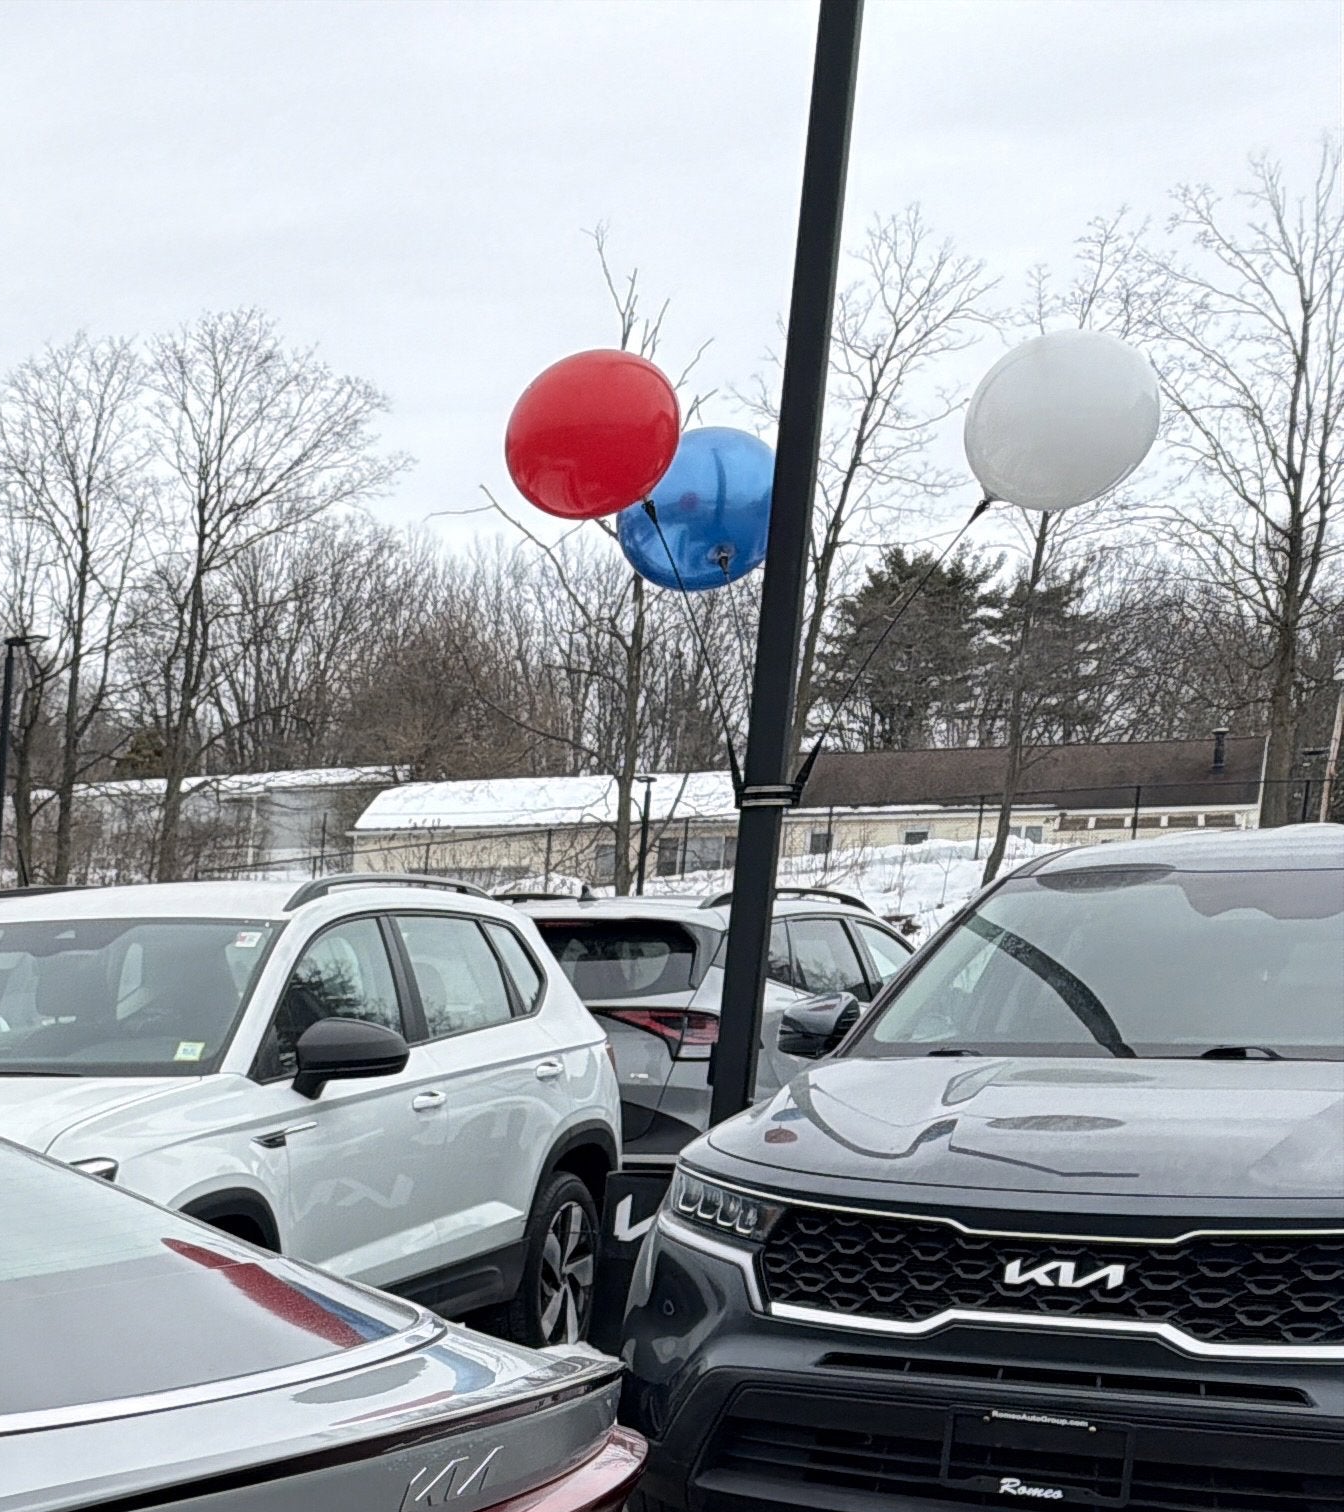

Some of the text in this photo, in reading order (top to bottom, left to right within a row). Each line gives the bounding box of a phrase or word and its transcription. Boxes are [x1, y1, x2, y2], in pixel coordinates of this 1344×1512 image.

[1004, 1258, 1125, 1289] KIA
[992, 1410, 1089, 1427] RomeoAutoGroup.com
[999, 1478, 1064, 1500] Romeo
